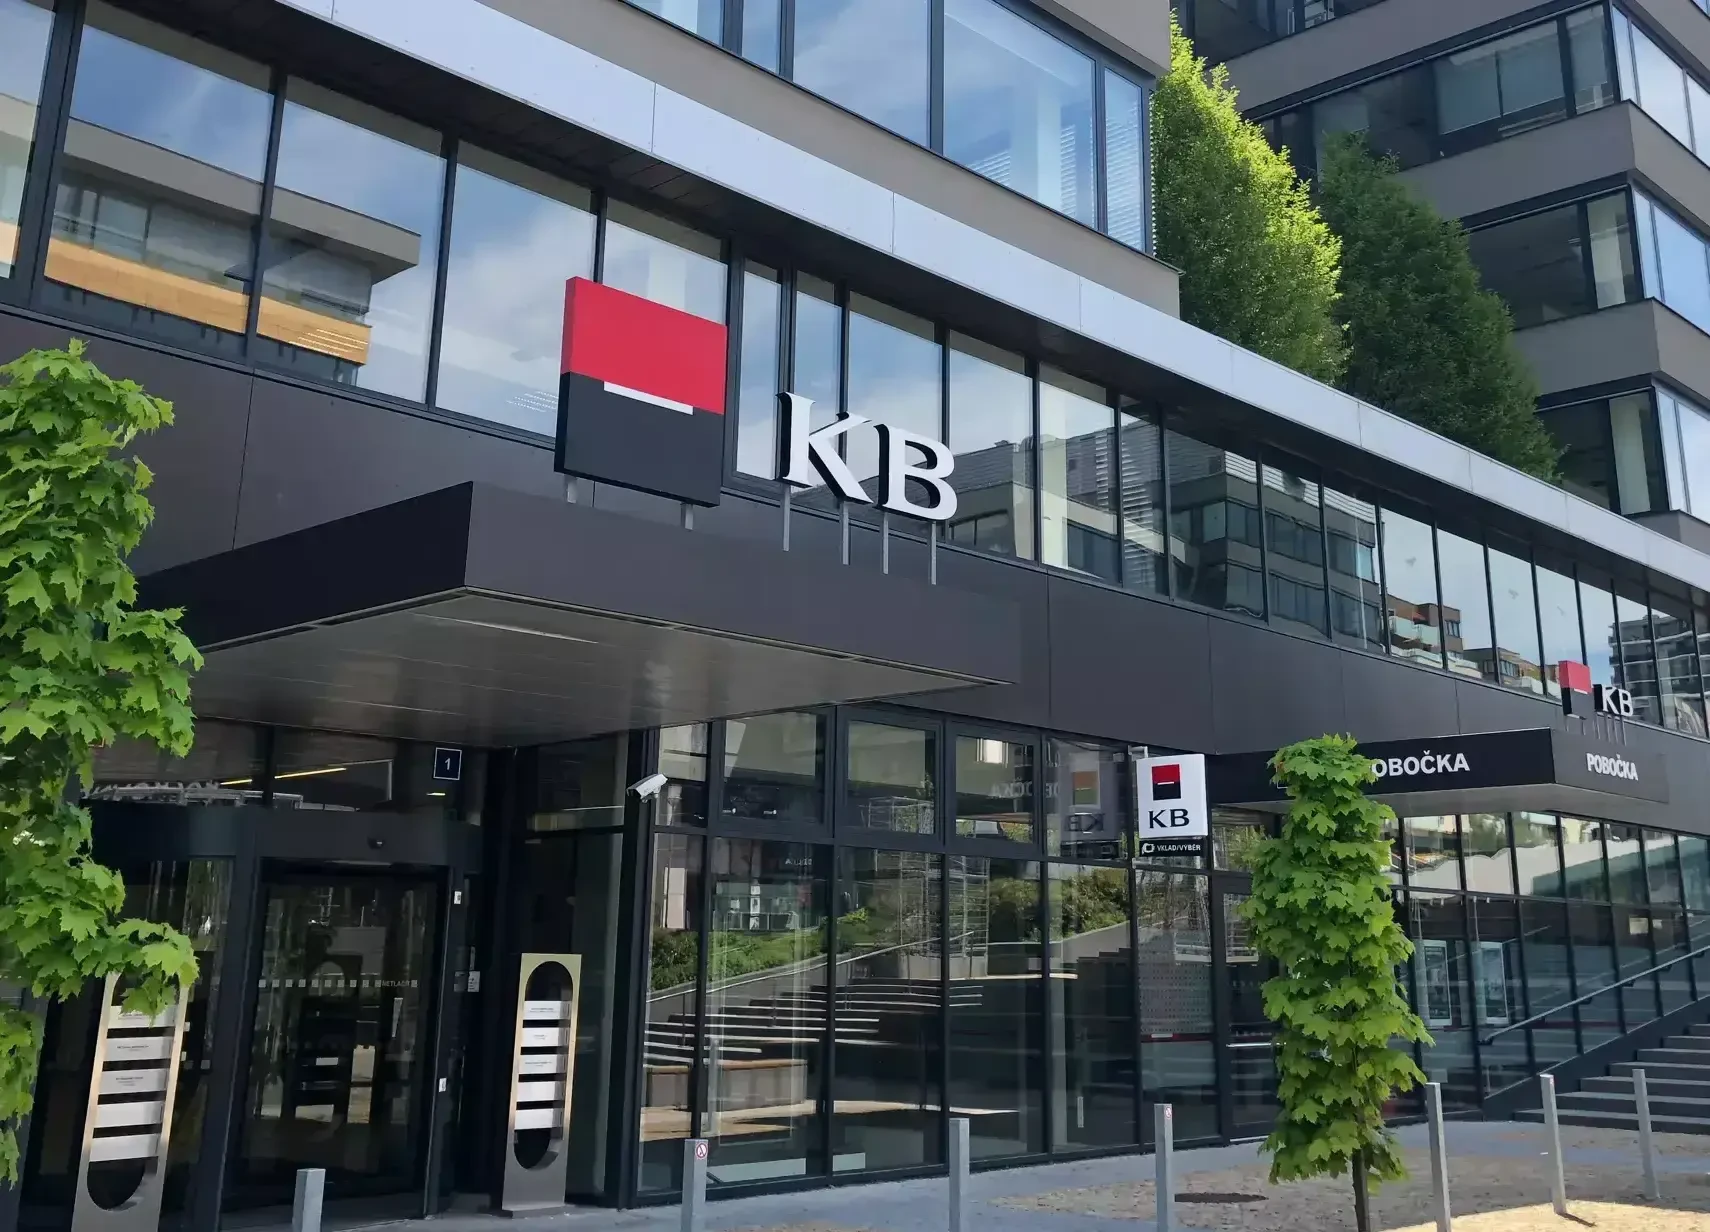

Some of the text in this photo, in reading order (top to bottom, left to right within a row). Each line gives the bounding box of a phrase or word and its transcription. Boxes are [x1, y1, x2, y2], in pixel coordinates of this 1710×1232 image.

[776, 391, 957, 520] KB
[1597, 685, 1634, 717] KB
[444, 757, 451, 771] 1
[1370, 750, 1470, 778] OBOČKA
[1586, 753, 1639, 781] POBOČKA
[1148, 808, 1190, 829] KB
